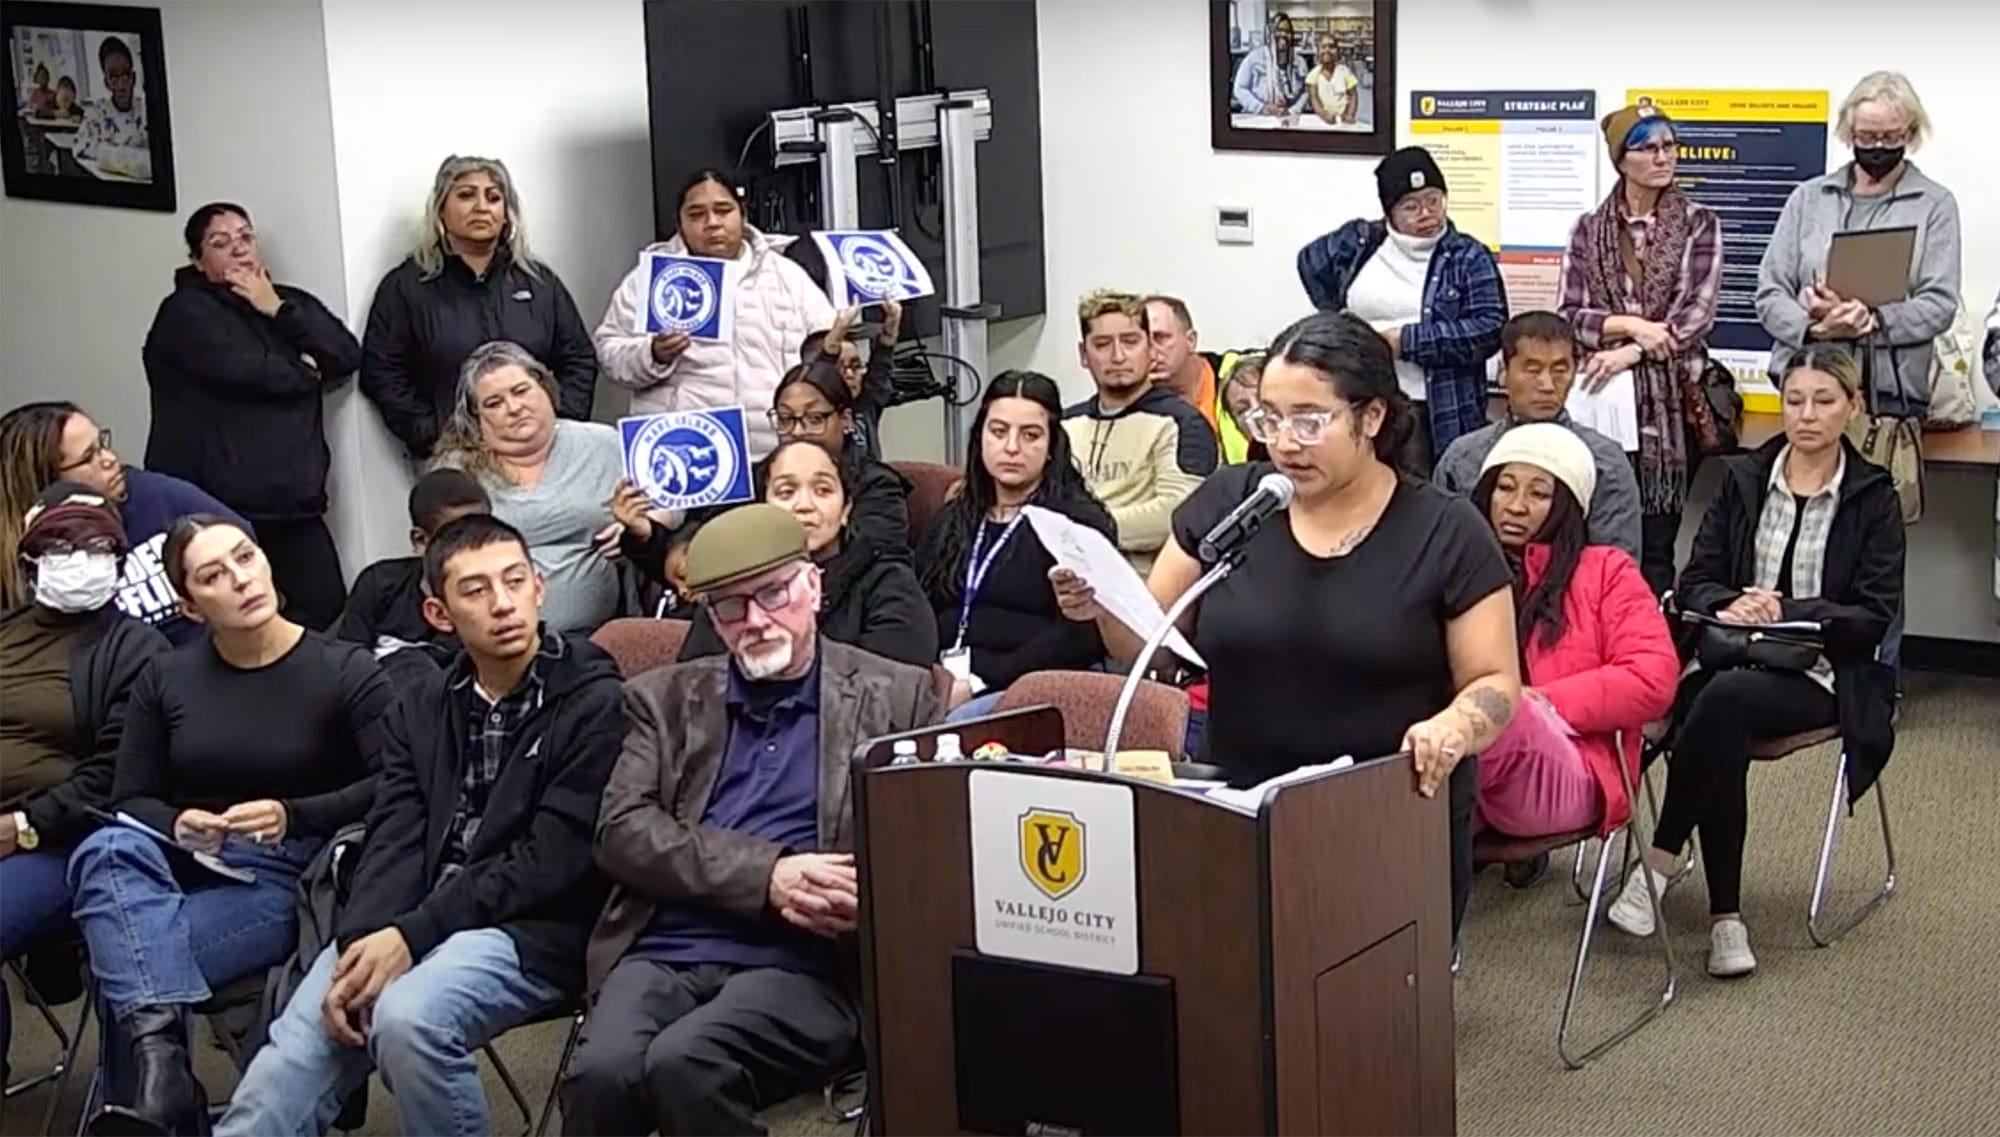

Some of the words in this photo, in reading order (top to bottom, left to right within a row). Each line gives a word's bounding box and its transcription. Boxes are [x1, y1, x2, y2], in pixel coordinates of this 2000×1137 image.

[1504, 101, 1557, 111] STRATEGIC
[1559, 101, 1587, 111] PLAN
[994, 899, 1069, 924] VALLEJO
[1074, 910, 1116, 931] CITY
[994, 919, 1032, 934] UNIFIED
[1034, 922, 1071, 940] SCHOOL
[1073, 929, 1117, 946] DISTRICT
